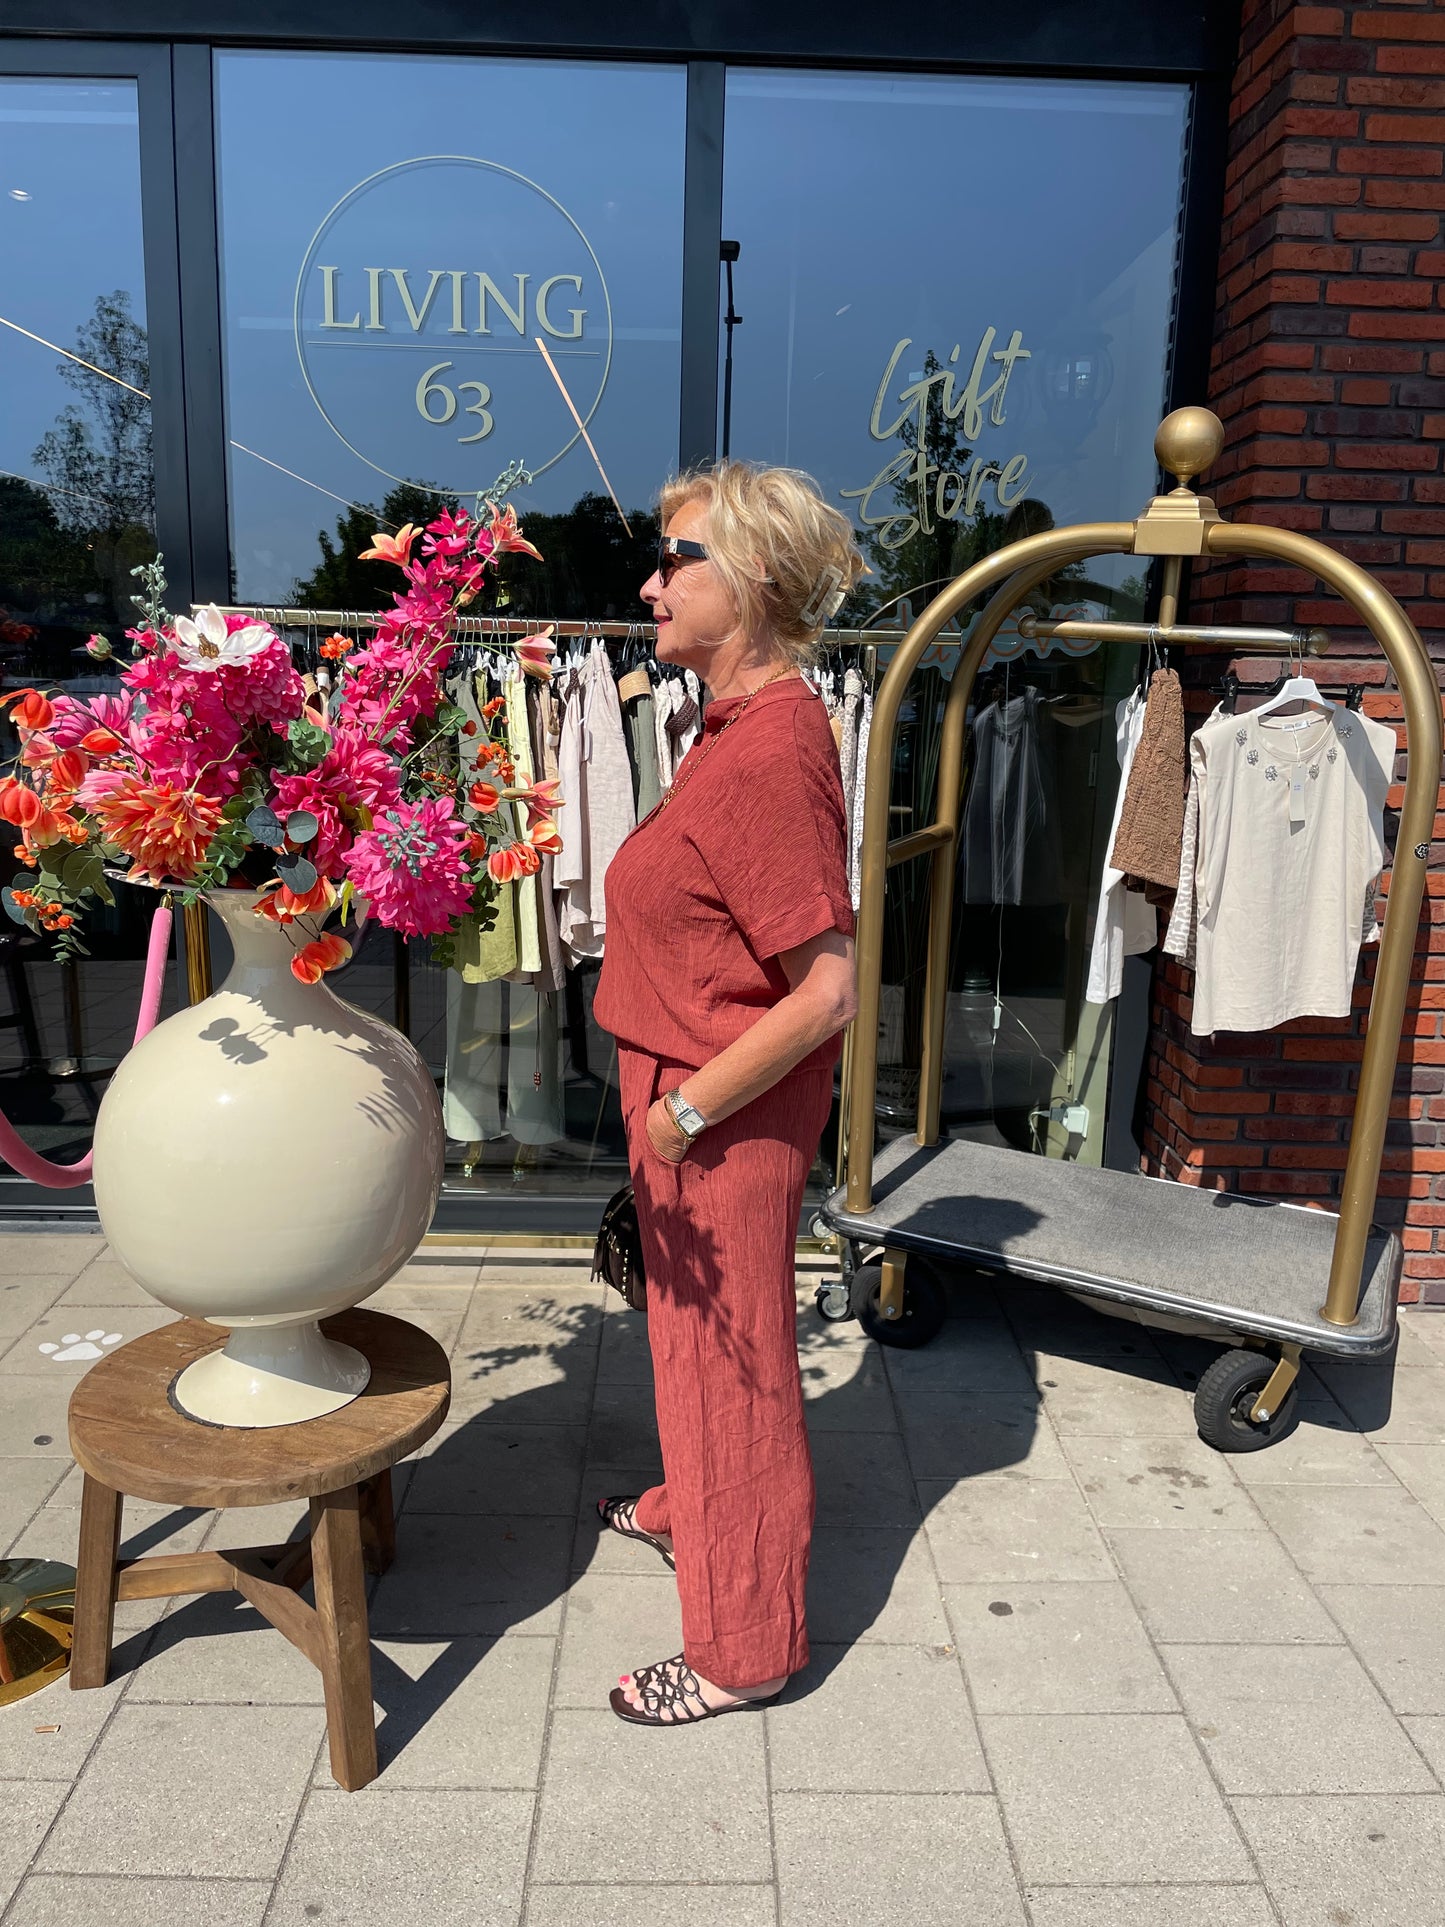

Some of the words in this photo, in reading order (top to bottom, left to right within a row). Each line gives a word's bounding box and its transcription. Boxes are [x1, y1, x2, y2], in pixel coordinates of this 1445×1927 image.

[317, 265, 588, 339] LIVING
[415, 361, 494, 443] 63
[870, 326, 1032, 452] Gift
[839, 448, 1039, 549] Store
